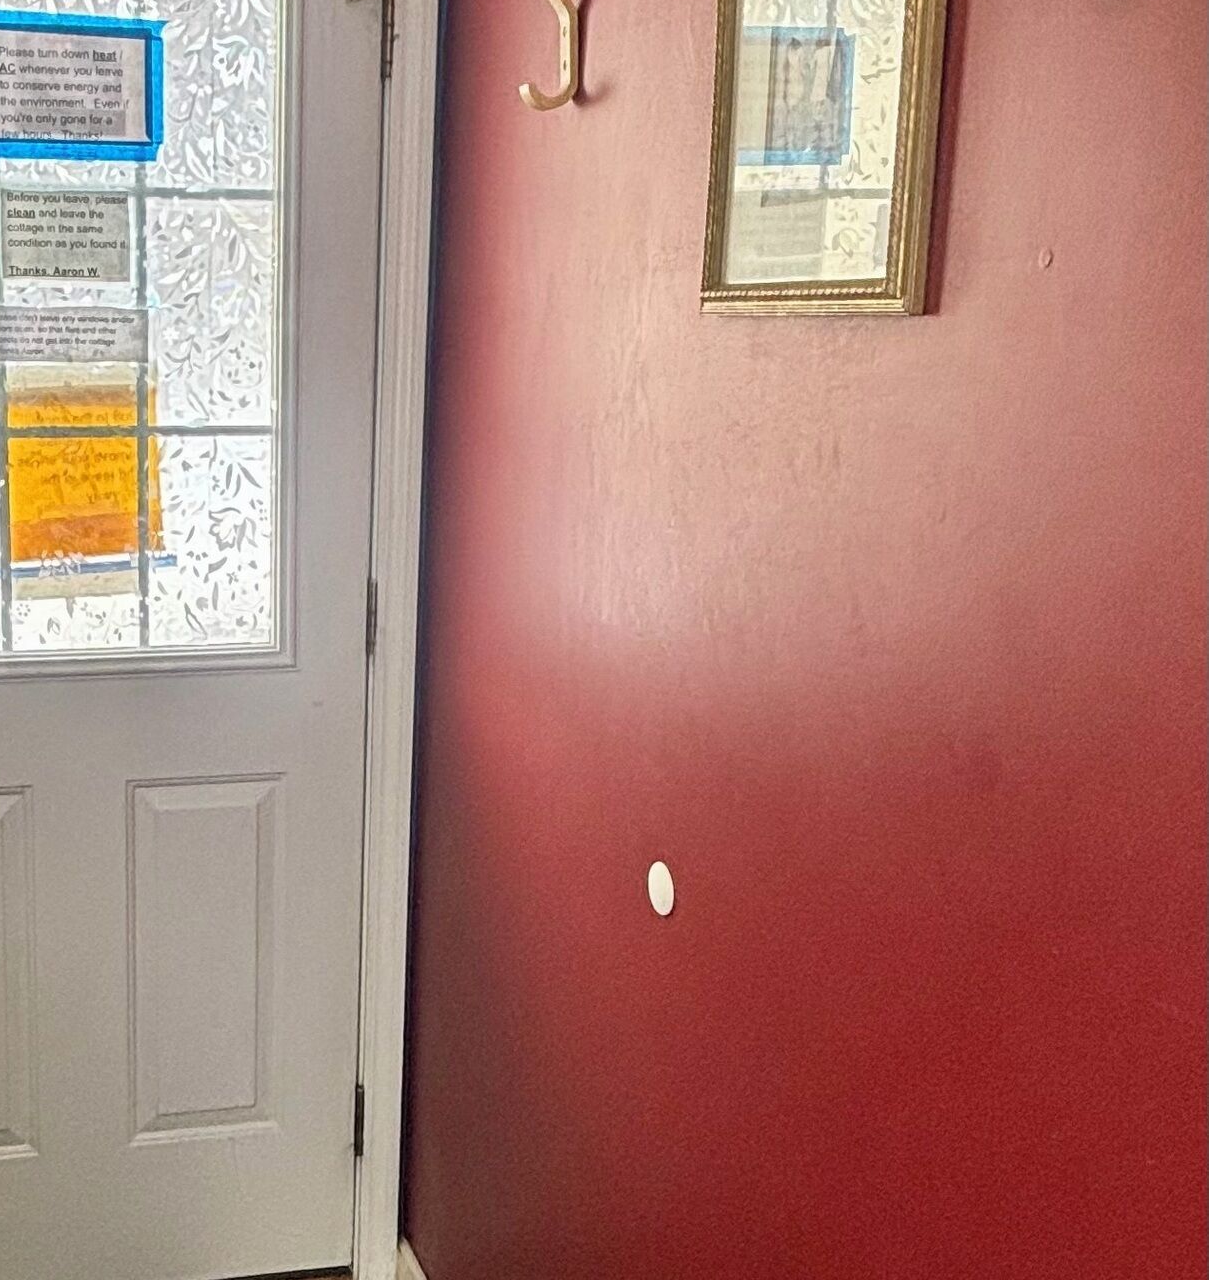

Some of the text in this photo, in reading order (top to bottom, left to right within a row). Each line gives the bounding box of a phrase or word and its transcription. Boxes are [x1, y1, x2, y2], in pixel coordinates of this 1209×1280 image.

[38, 47, 59, 58] turn
[61, 49, 89, 59] down
[92, 49, 117, 62] heat
[0, 63, 123, 78] AC whenever you leave
[0, 80, 122, 95] to conserve energy and
[0, 96, 17, 106] the
[94, 98, 120, 109] Even
[0, 112, 113, 126] you're only gone for a
[6, 192, 39, 202] Before
[42, 194, 60, 204] you
[95, 195, 128, 205] please
[7, 208, 104, 219] clean and leave the
[7, 223, 44, 234] cottage
[47, 224, 56, 233] in
[58, 224, 74, 233] the
[7, 239, 52, 248] condition
[55, 240, 67, 248] as
[69, 240, 87, 250] you
[90, 239, 117, 249] found
[53, 266, 85, 277] Aaron
[86, 267, 100, 278] W.
